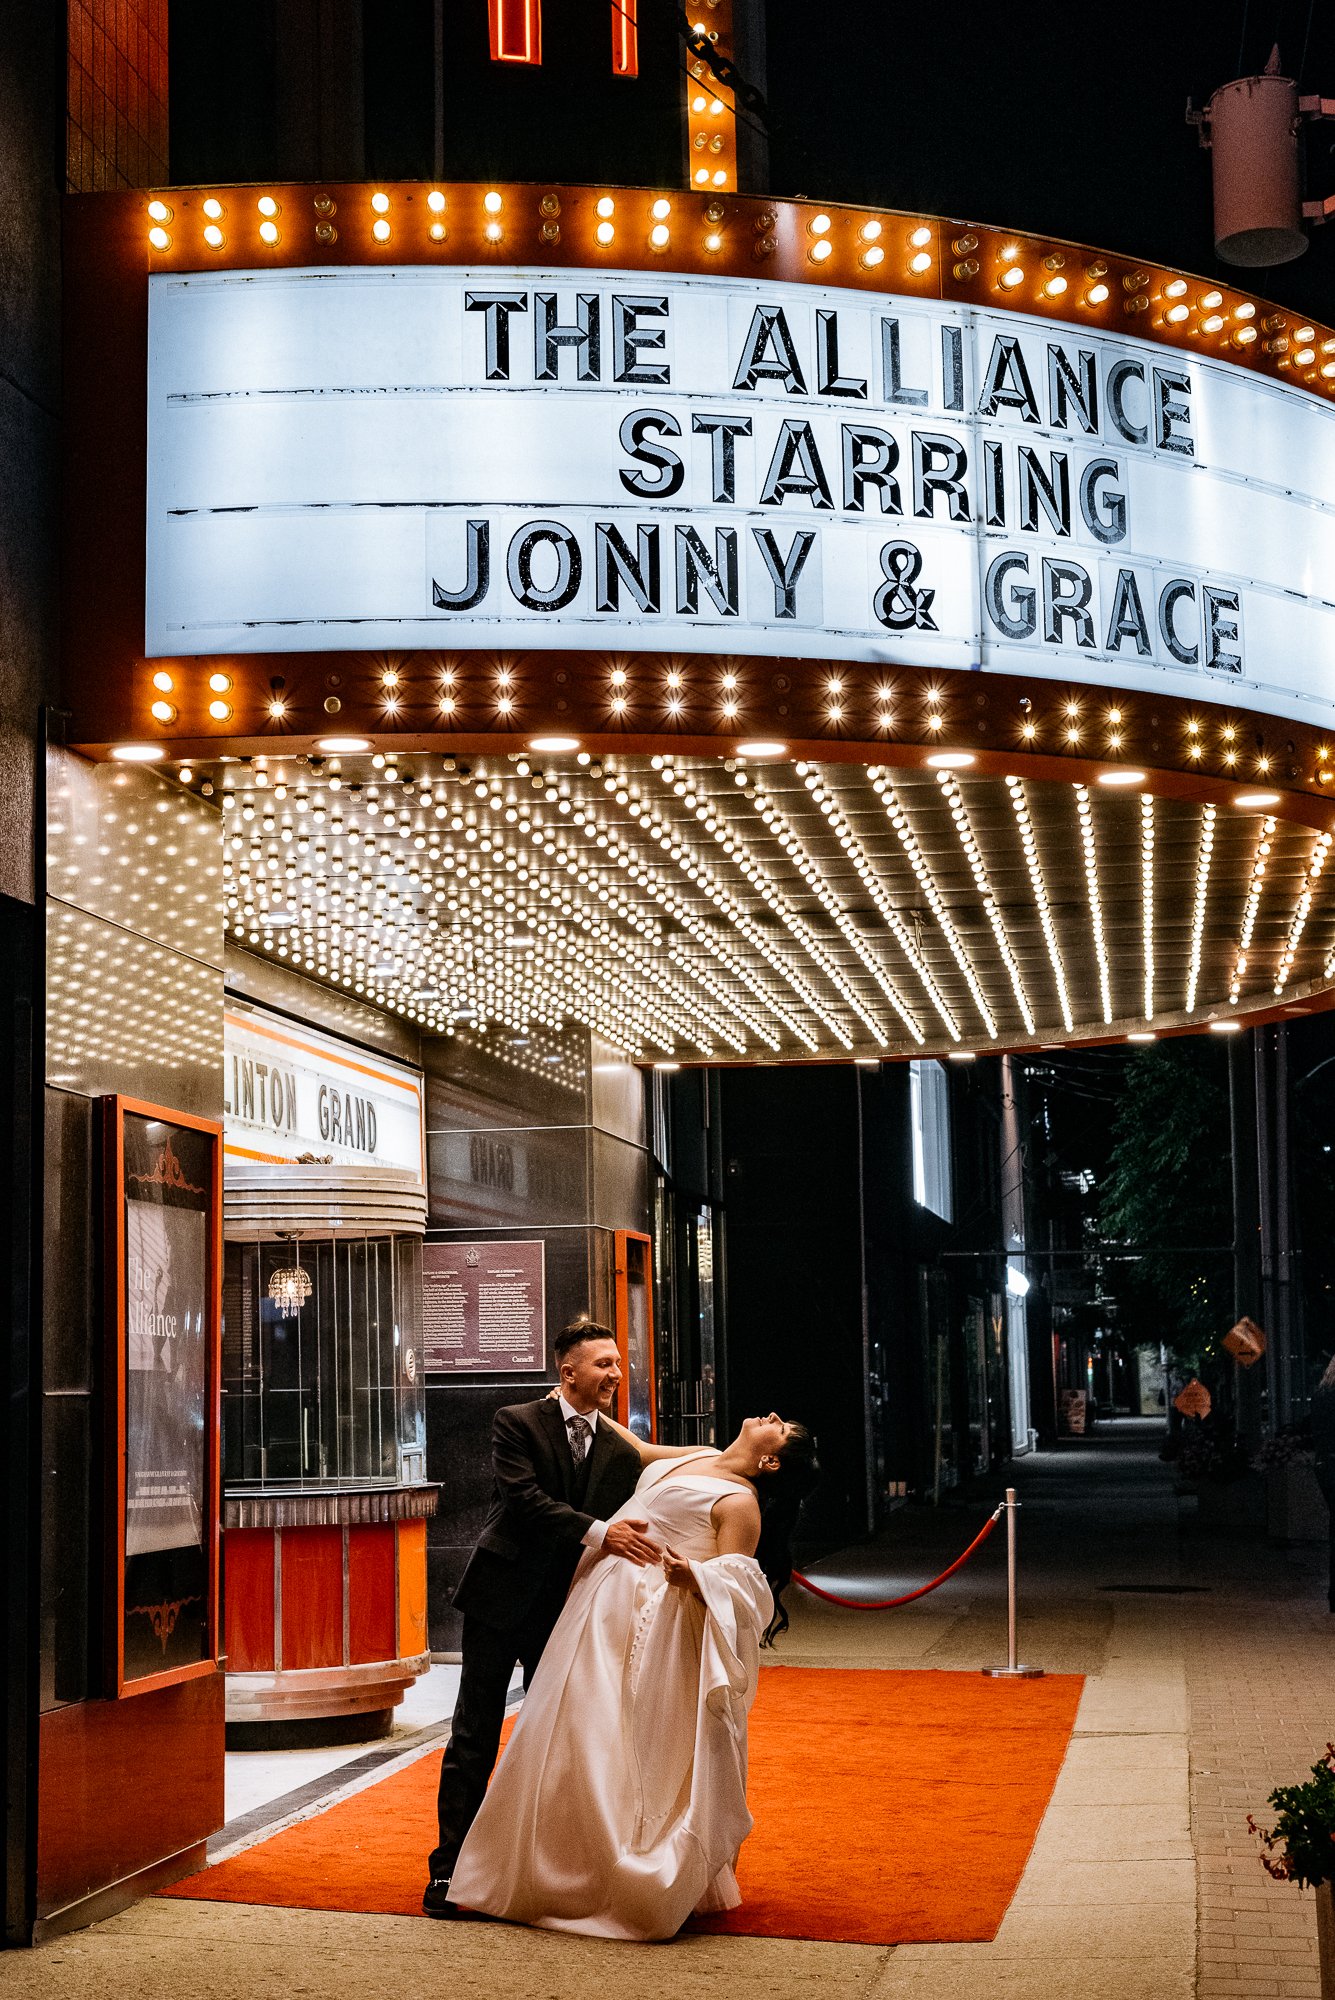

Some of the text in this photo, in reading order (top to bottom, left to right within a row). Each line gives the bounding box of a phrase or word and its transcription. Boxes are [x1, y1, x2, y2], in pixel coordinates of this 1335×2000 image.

[464, 291, 1195, 456] THE ALLIANCE
[619, 408, 1127, 544] STARRING
[432, 519, 1243, 675] JONNY & GRACE
[319, 1084, 377, 1153] GRAND
